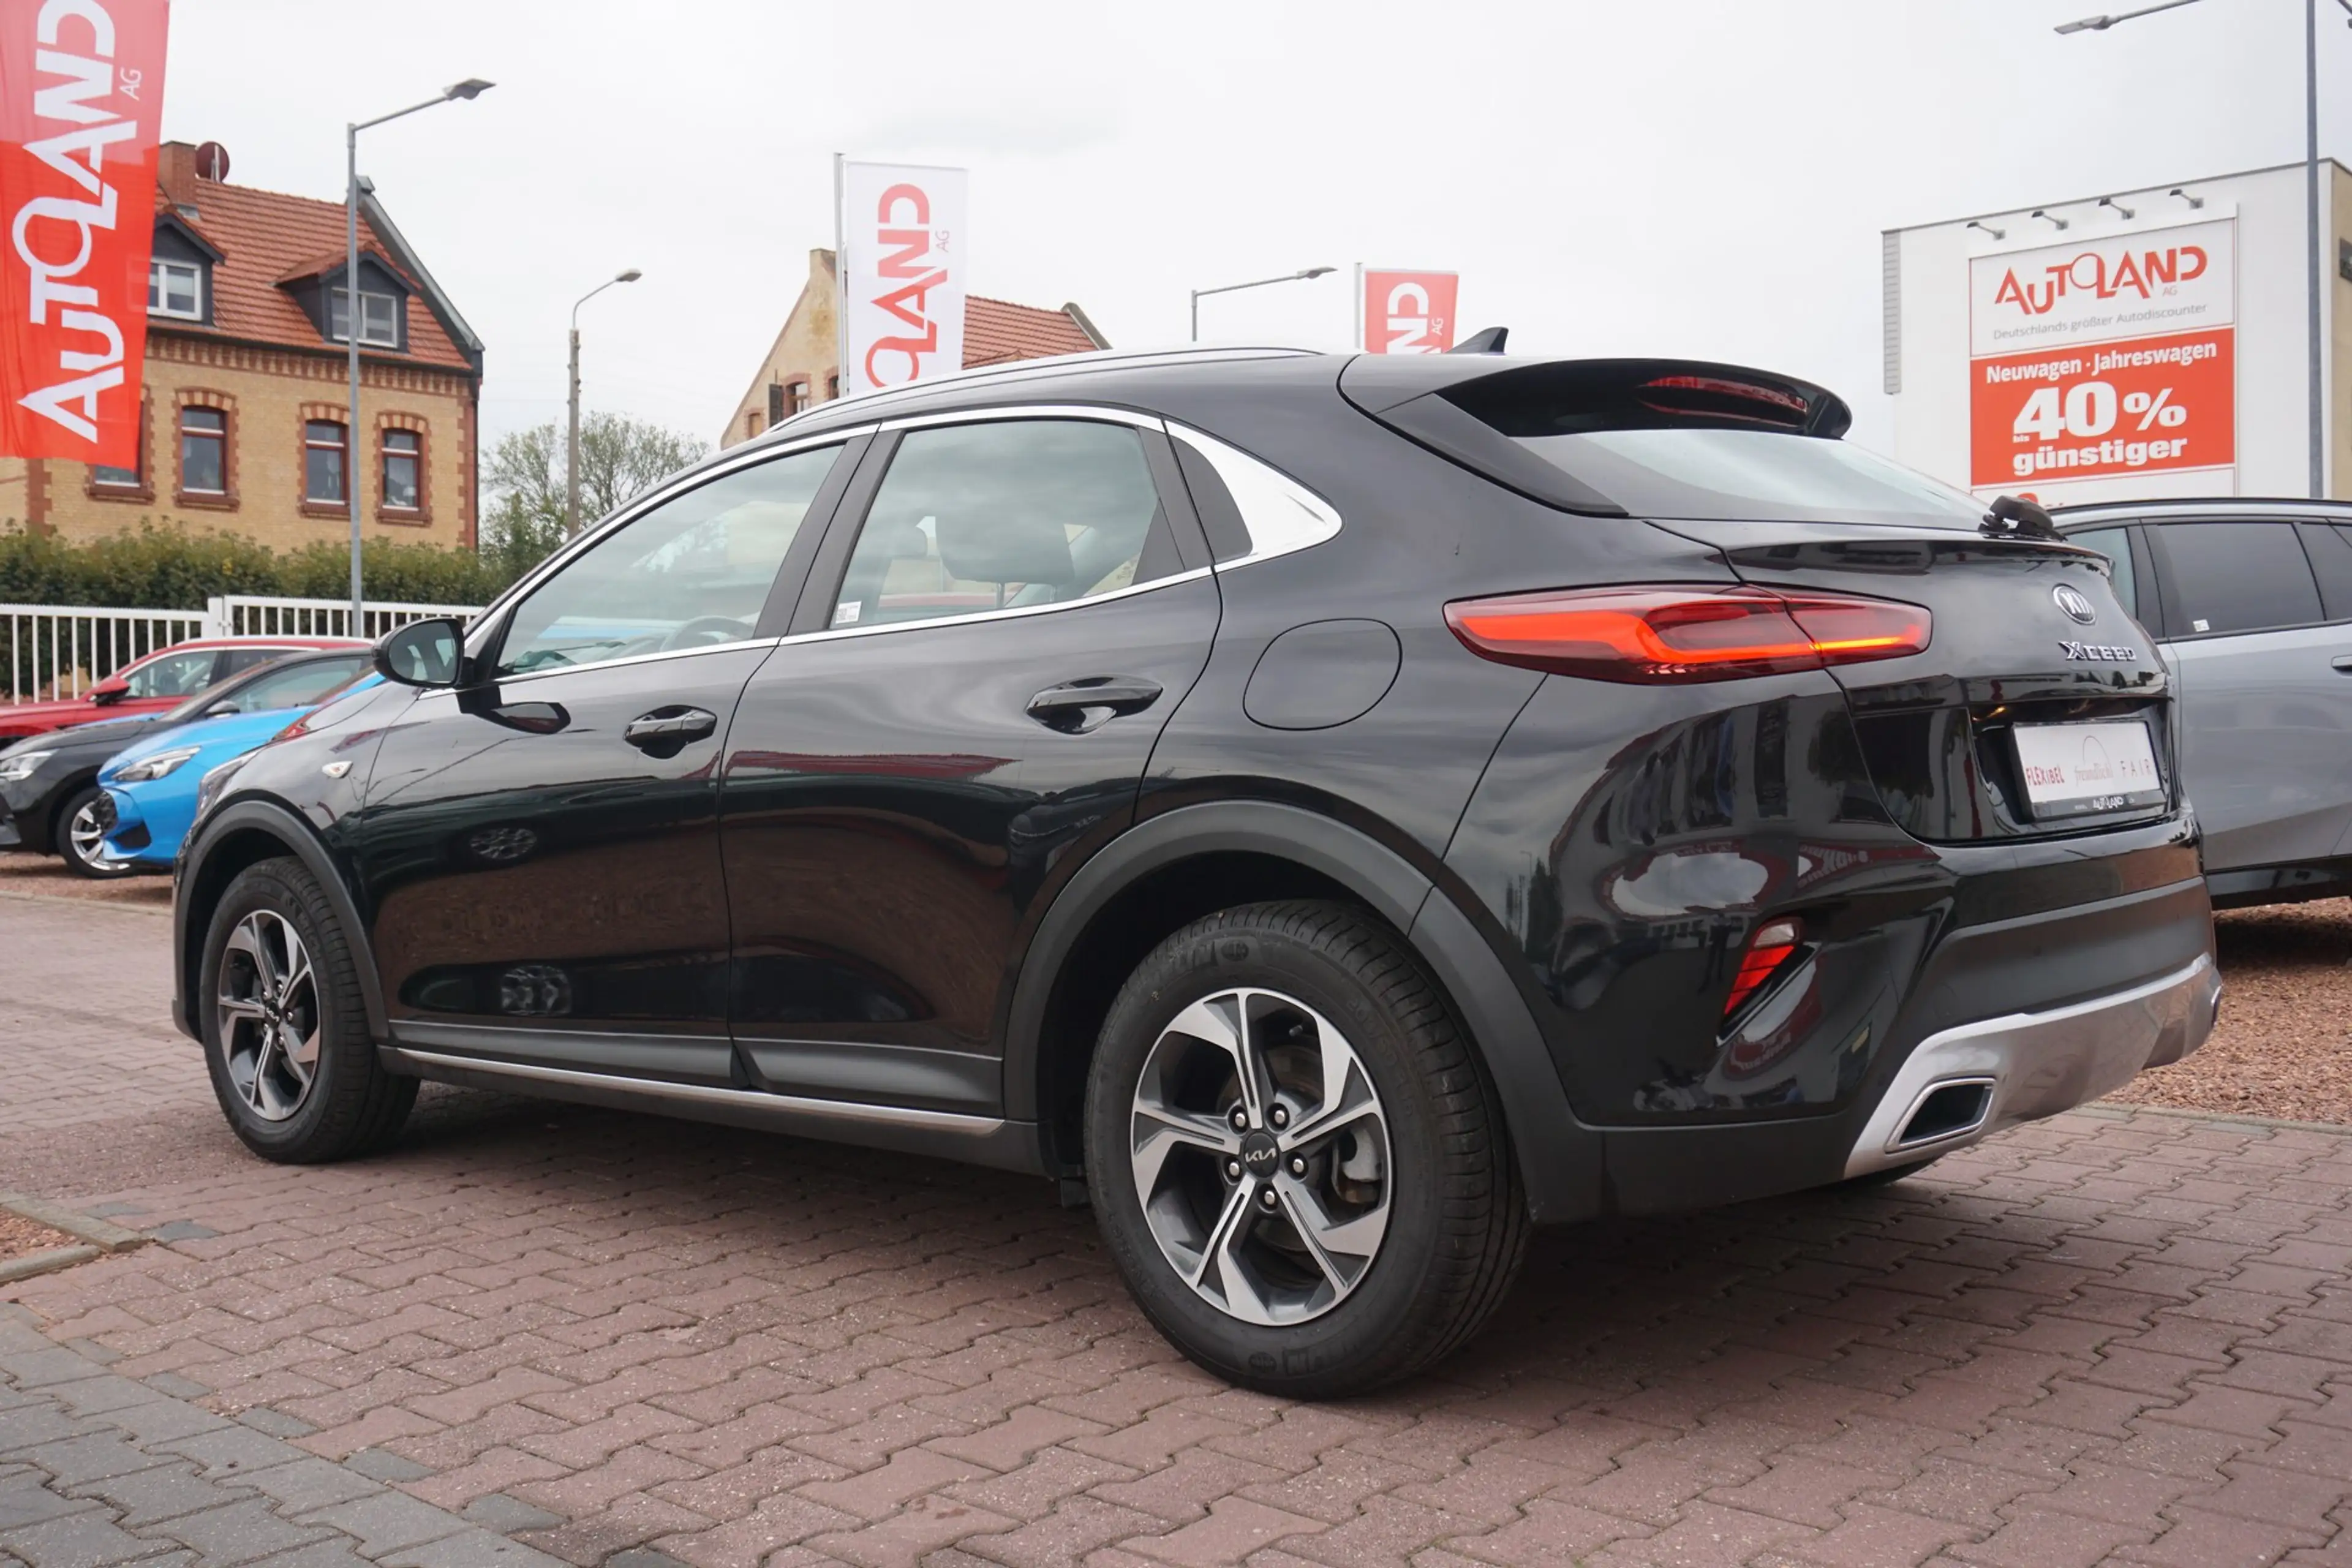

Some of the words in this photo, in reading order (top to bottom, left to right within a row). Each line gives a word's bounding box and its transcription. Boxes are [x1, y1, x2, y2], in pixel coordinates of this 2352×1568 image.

[119, 67, 141, 101] AG
[12, 0, 137, 443] AUTOLAND
[935, 230, 949, 252] AG
[865, 183, 948, 387] OLAND
[1994, 246, 2208, 315] AUTOLAND
[2162, 285, 2178, 297] AG
[1431, 317, 1444, 336] AG
[1994, 321, 2068, 340] Deutschlands
[2071, 316, 2113, 333] größter
[2116, 304, 2207, 323] Autodiscounter
[1986, 358, 2081, 383] Neuwagen
[2091, 342, 2217, 376] Jahreswagen
[2013, 437, 2187, 476] günstiger
[2120, 758, 2153, 777] FAIR
[1245, 1147, 1276, 1163] KIA
